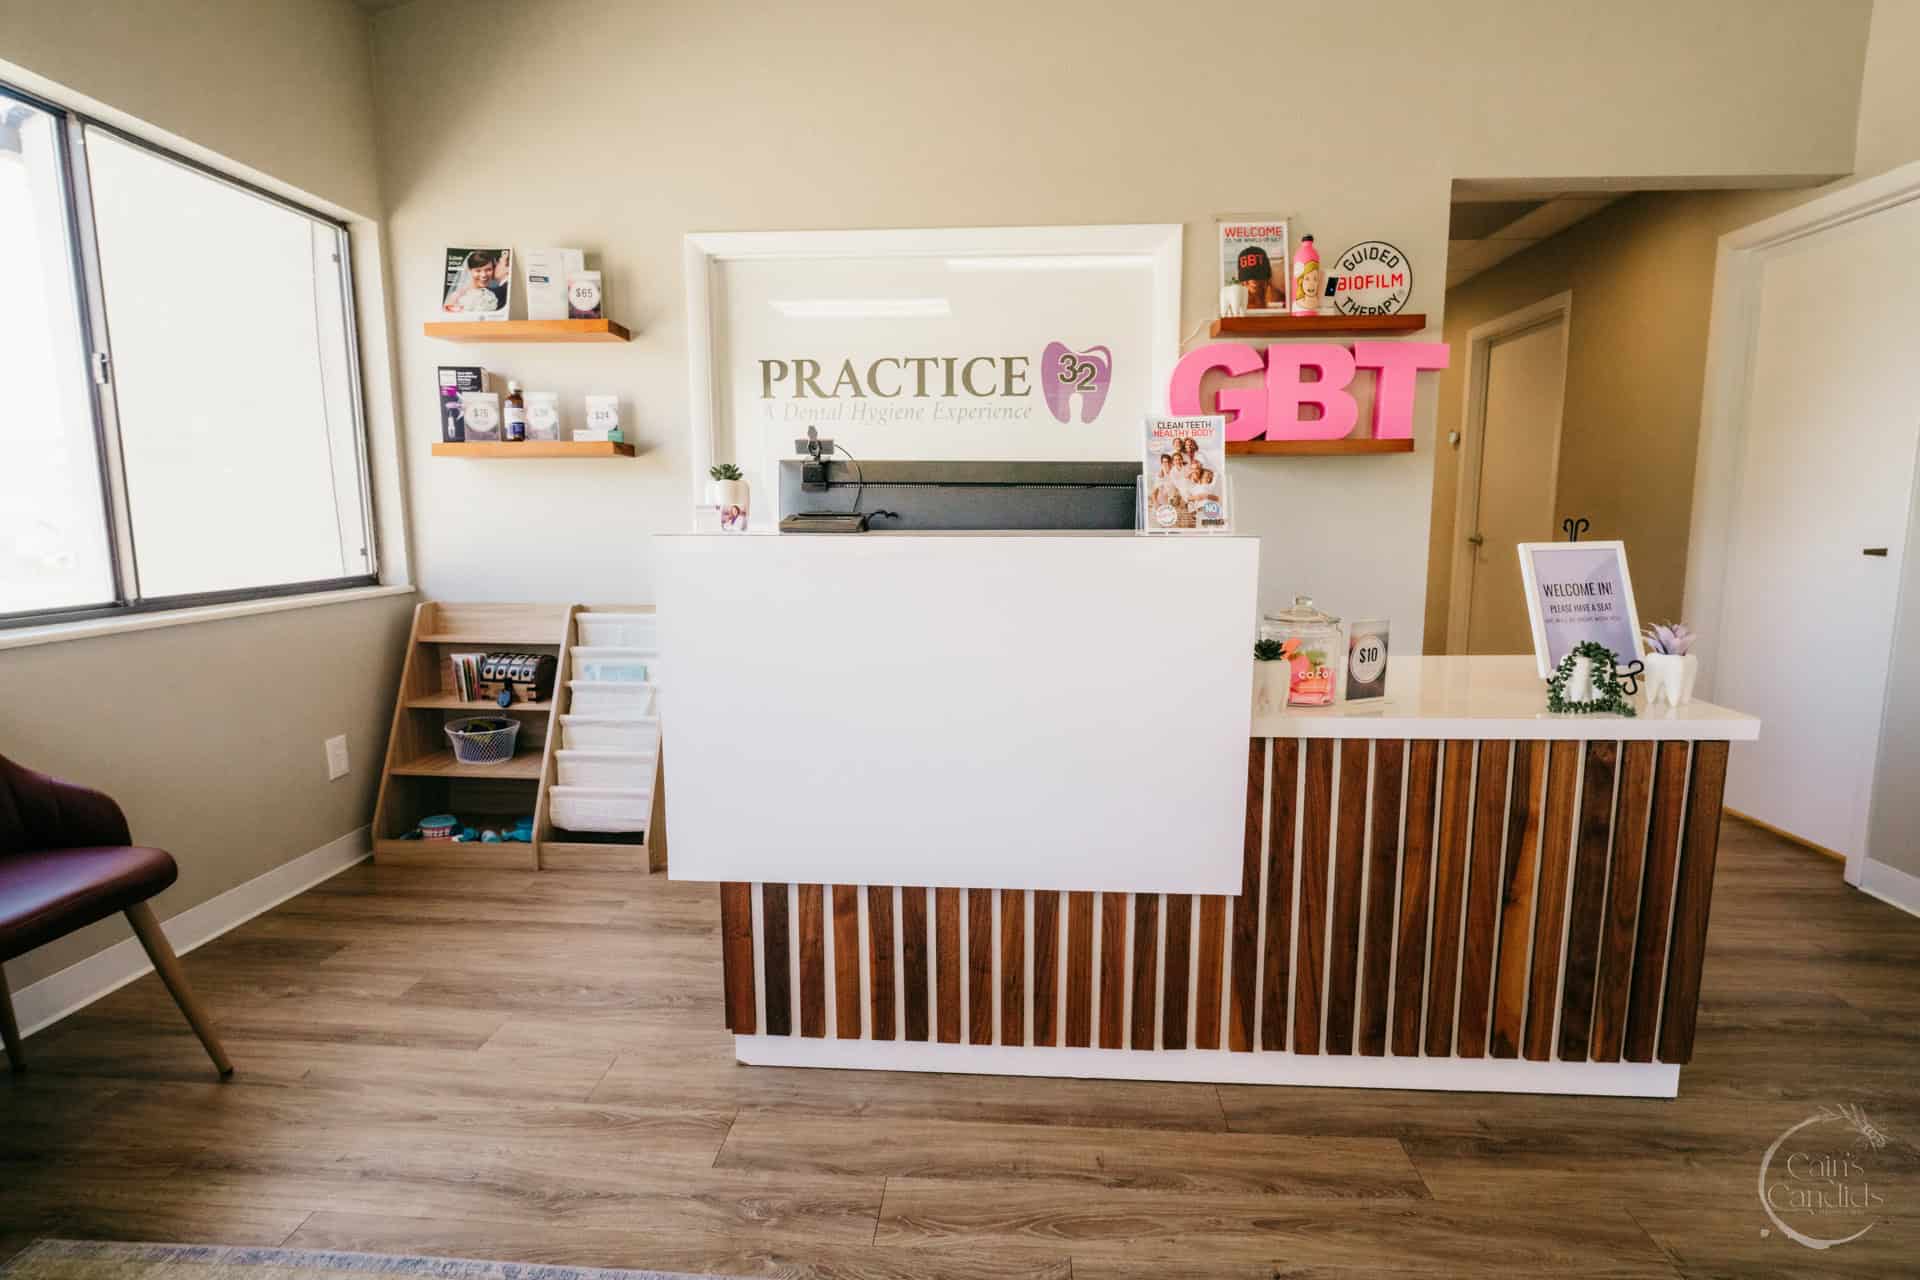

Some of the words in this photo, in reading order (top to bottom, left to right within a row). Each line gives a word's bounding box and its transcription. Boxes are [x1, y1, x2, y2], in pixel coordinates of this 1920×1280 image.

[1225, 226, 1282, 238] WELCOME
[1239, 254, 1264, 268] GBT
[1343, 246, 1400, 271] GUIDED
[1337, 273, 1404, 292] BIOFILM
[575, 287, 593, 298] $65
[758, 356, 1033, 399] PRACTICE
[1057, 353, 1097, 391] 32
[1169, 342, 1451, 441] GBT
[783, 402, 842, 421] Dental
[848, 402, 925, 424] Hygiene
[932, 402, 1033, 425] Experience
[1152, 429, 1189, 437] HEALTHY
[1191, 428, 1215, 437] BODY
[1157, 421, 1184, 429] CLEAN
[1186, 420, 1212, 428] TEETH
[1543, 582, 1596, 597] WELCOME
[1598, 581, 1613, 596] IN!
[1550, 603, 1572, 614] PLEASE
[1573, 603, 1590, 612] HAVE
[1591, 603, 1597, 612] A
[1597, 602, 1612, 612] SEAT
[1359, 647, 1378, 663] $10
